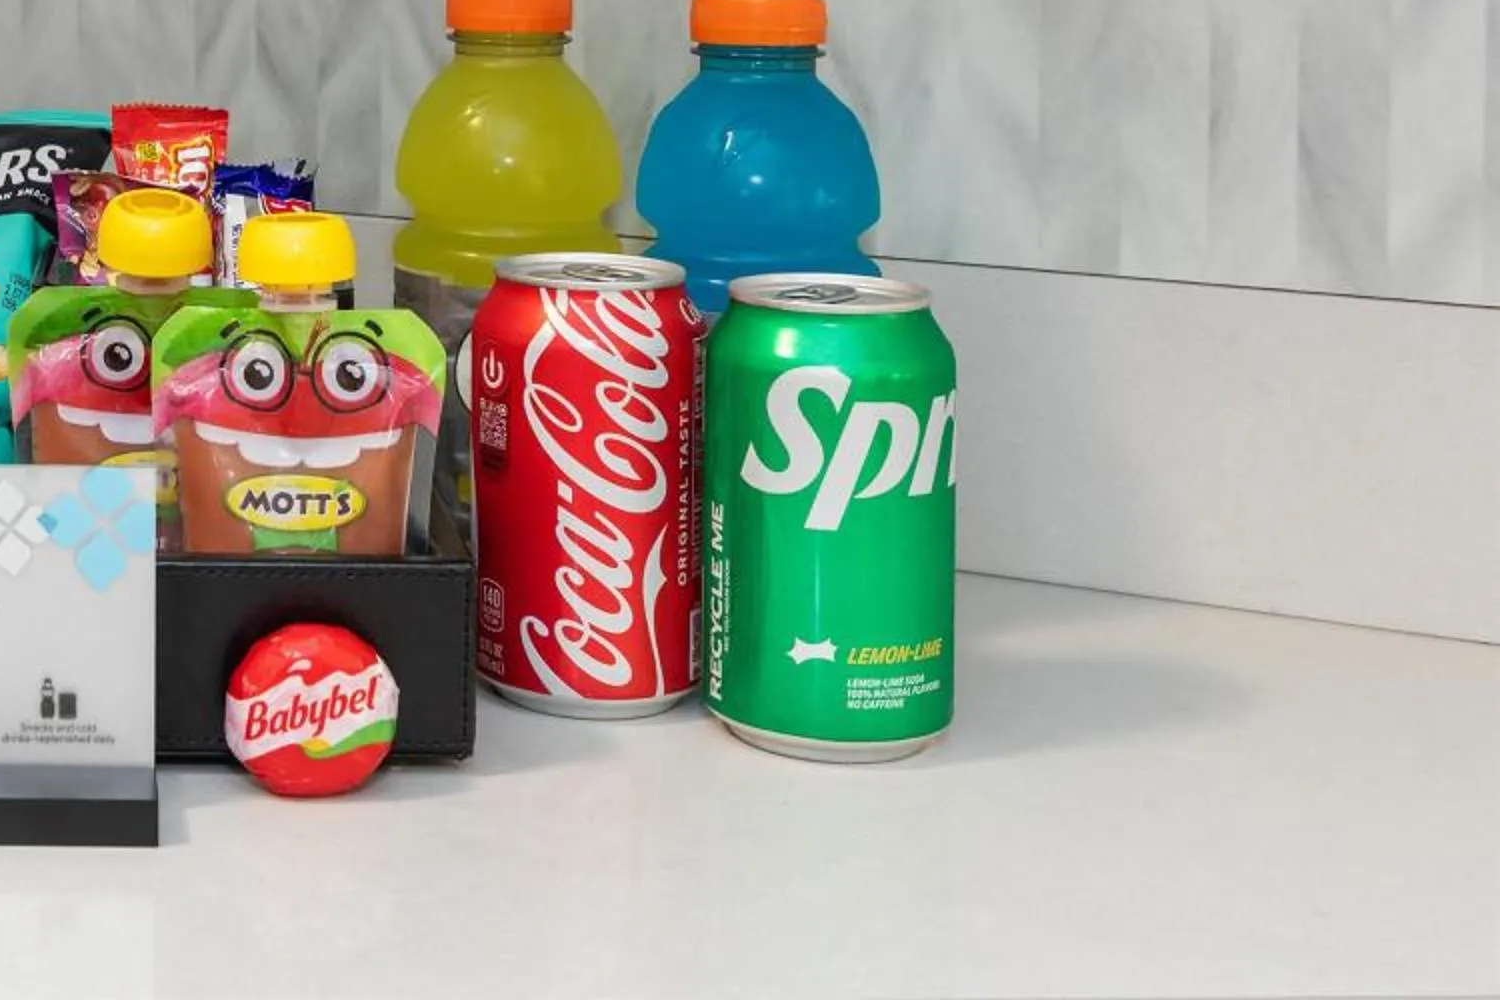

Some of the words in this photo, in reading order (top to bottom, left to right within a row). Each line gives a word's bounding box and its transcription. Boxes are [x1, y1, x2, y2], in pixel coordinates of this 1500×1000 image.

[678, 399, 689, 471] TASTE
[519, 286, 670, 700] Coca-Cola
[711, 501, 724, 553] ME
[677, 476, 689, 586] ORIGINAL
[709, 556, 724, 701] RECYCLE
[847, 638, 943, 665] LEMON-LIME
[243, 676, 378, 741] Babybel
